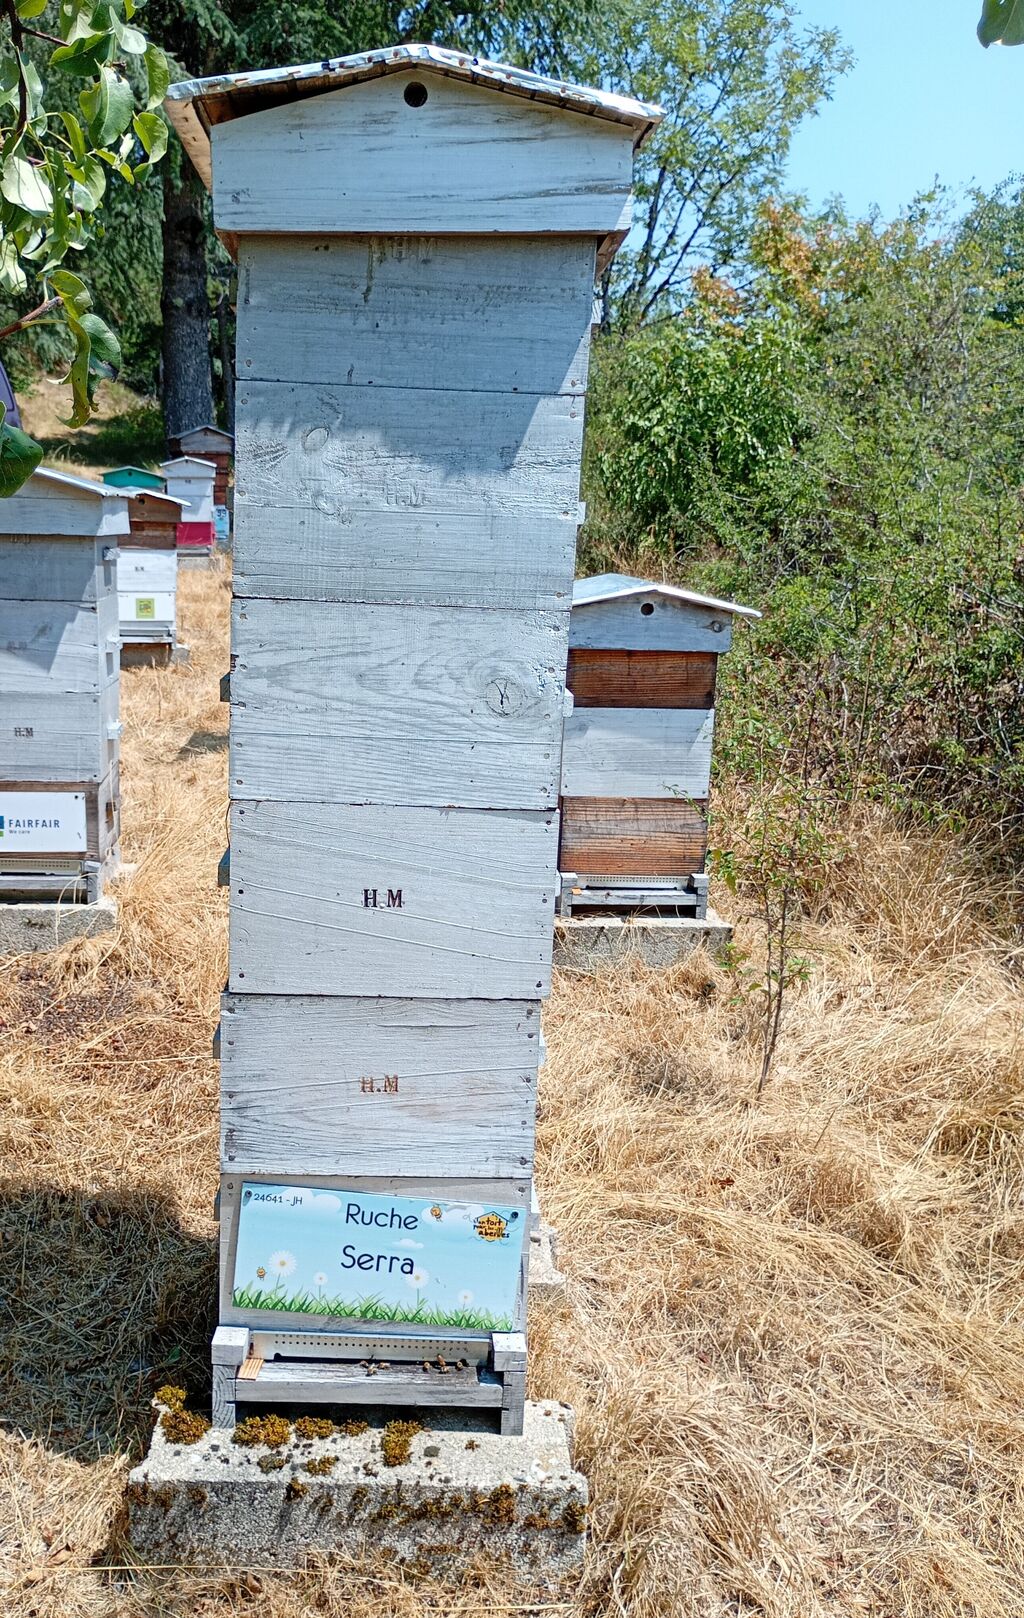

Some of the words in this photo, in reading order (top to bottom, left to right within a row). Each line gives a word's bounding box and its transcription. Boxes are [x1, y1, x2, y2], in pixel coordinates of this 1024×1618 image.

[8, 819, 60, 828] FAIRFAIR
[359, 1074, 398, 1093] H.M
[253, 1193, 283, 1204] 24641
[290, 1195, 303, 1207] JH
[345, 1203, 419, 1230] Ruche
[340, 1245, 414, 1275] Serra
